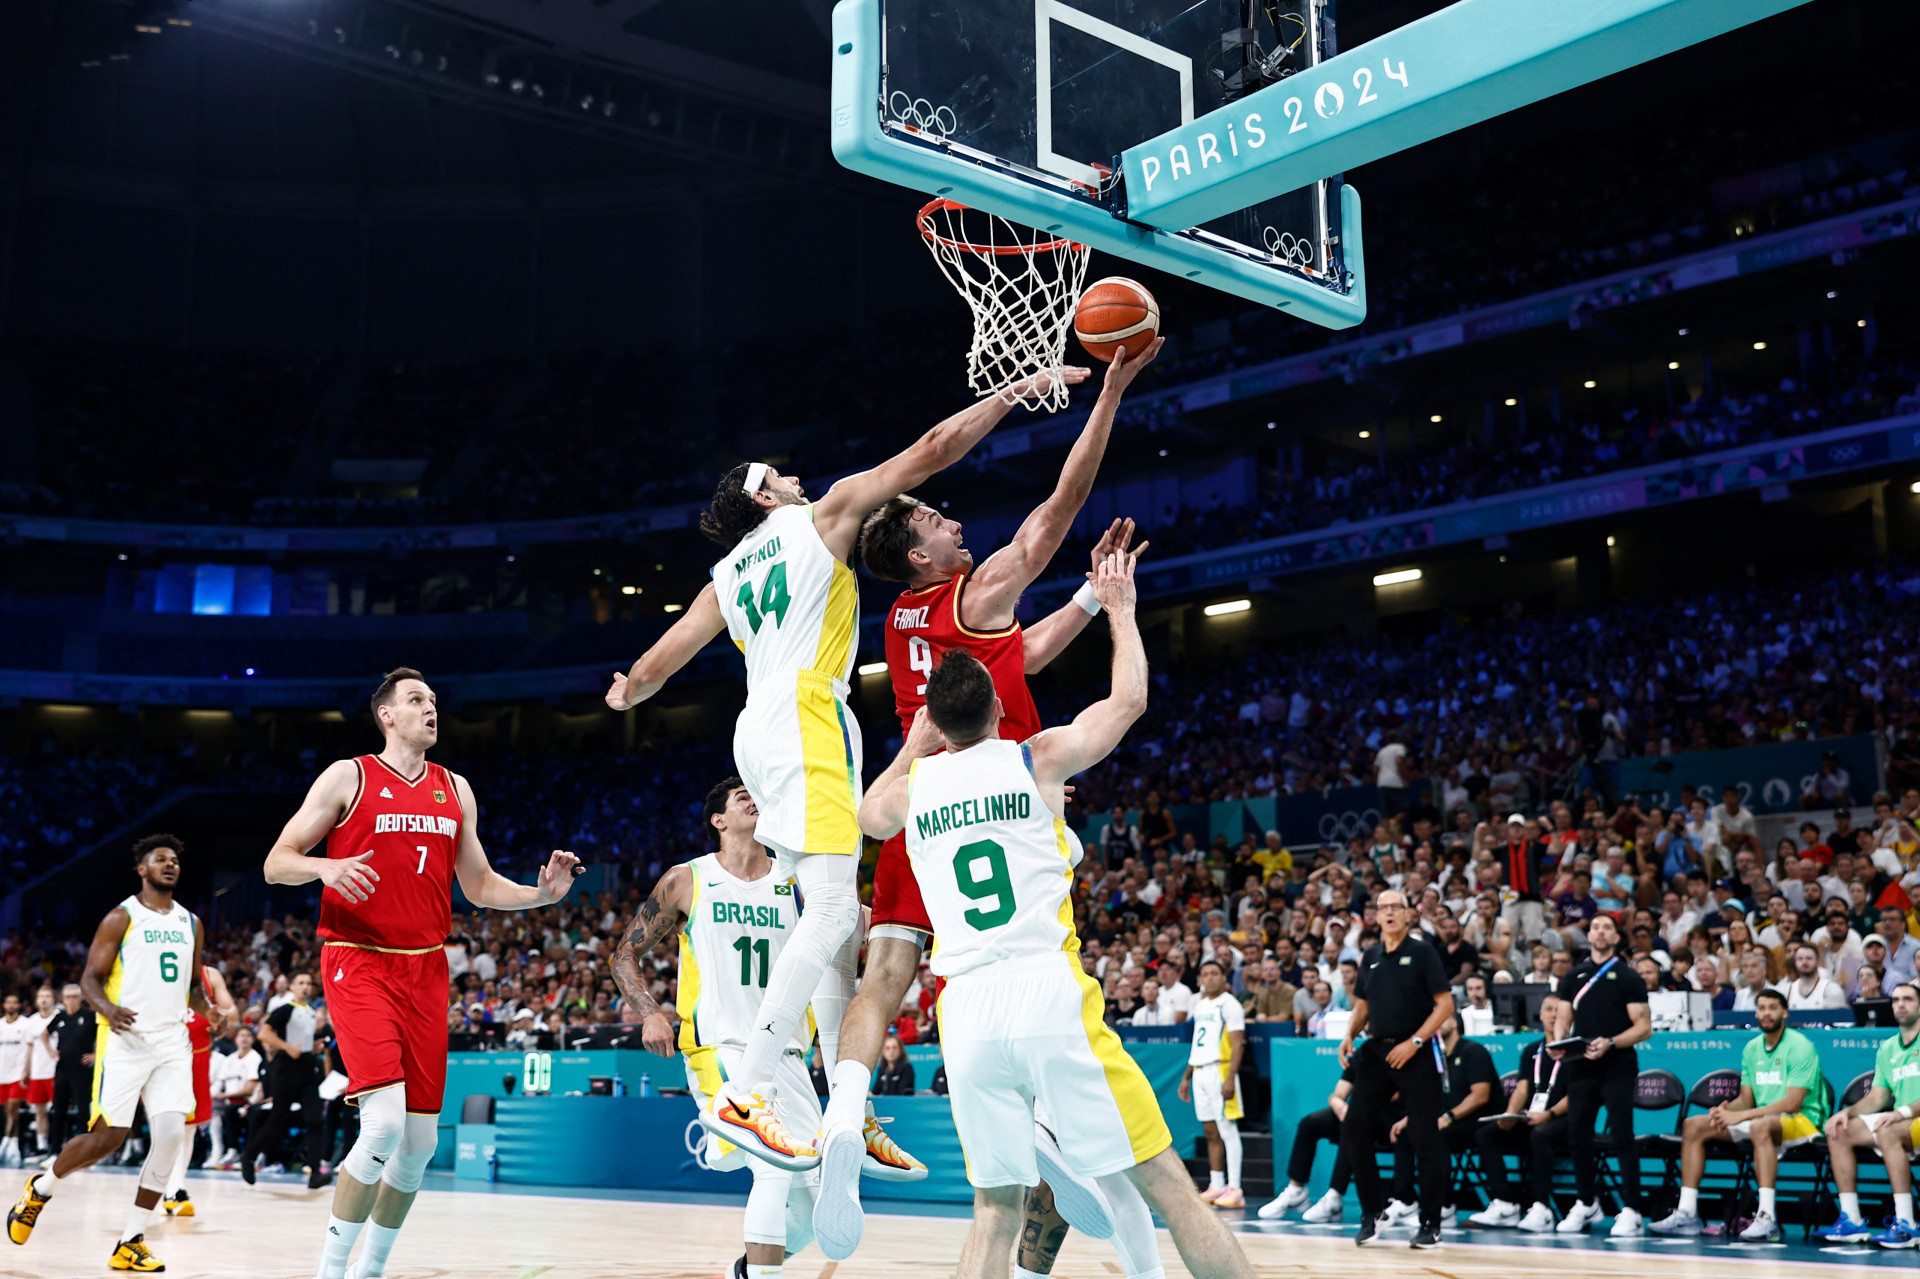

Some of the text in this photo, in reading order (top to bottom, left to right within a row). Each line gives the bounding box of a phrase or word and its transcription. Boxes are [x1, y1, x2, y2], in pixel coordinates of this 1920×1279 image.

[1283, 58, 1409, 135] 2024
[737, 561, 792, 636] 14
[893, 605, 930, 630] FRANZ
[909, 635, 933, 696] 9
[375, 813, 458, 840] DEUTSCHLAND
[916, 792, 1030, 840] MARCELINHO
[416, 845, 428, 874] 7
[952, 838, 1017, 932] 9
[712, 901, 786, 930] BRASIL
[144, 930, 188, 945] BRASIL
[160, 951, 178, 983] 6
[732, 935, 770, 989] 11
[1196, 1027, 1206, 1047] 2
